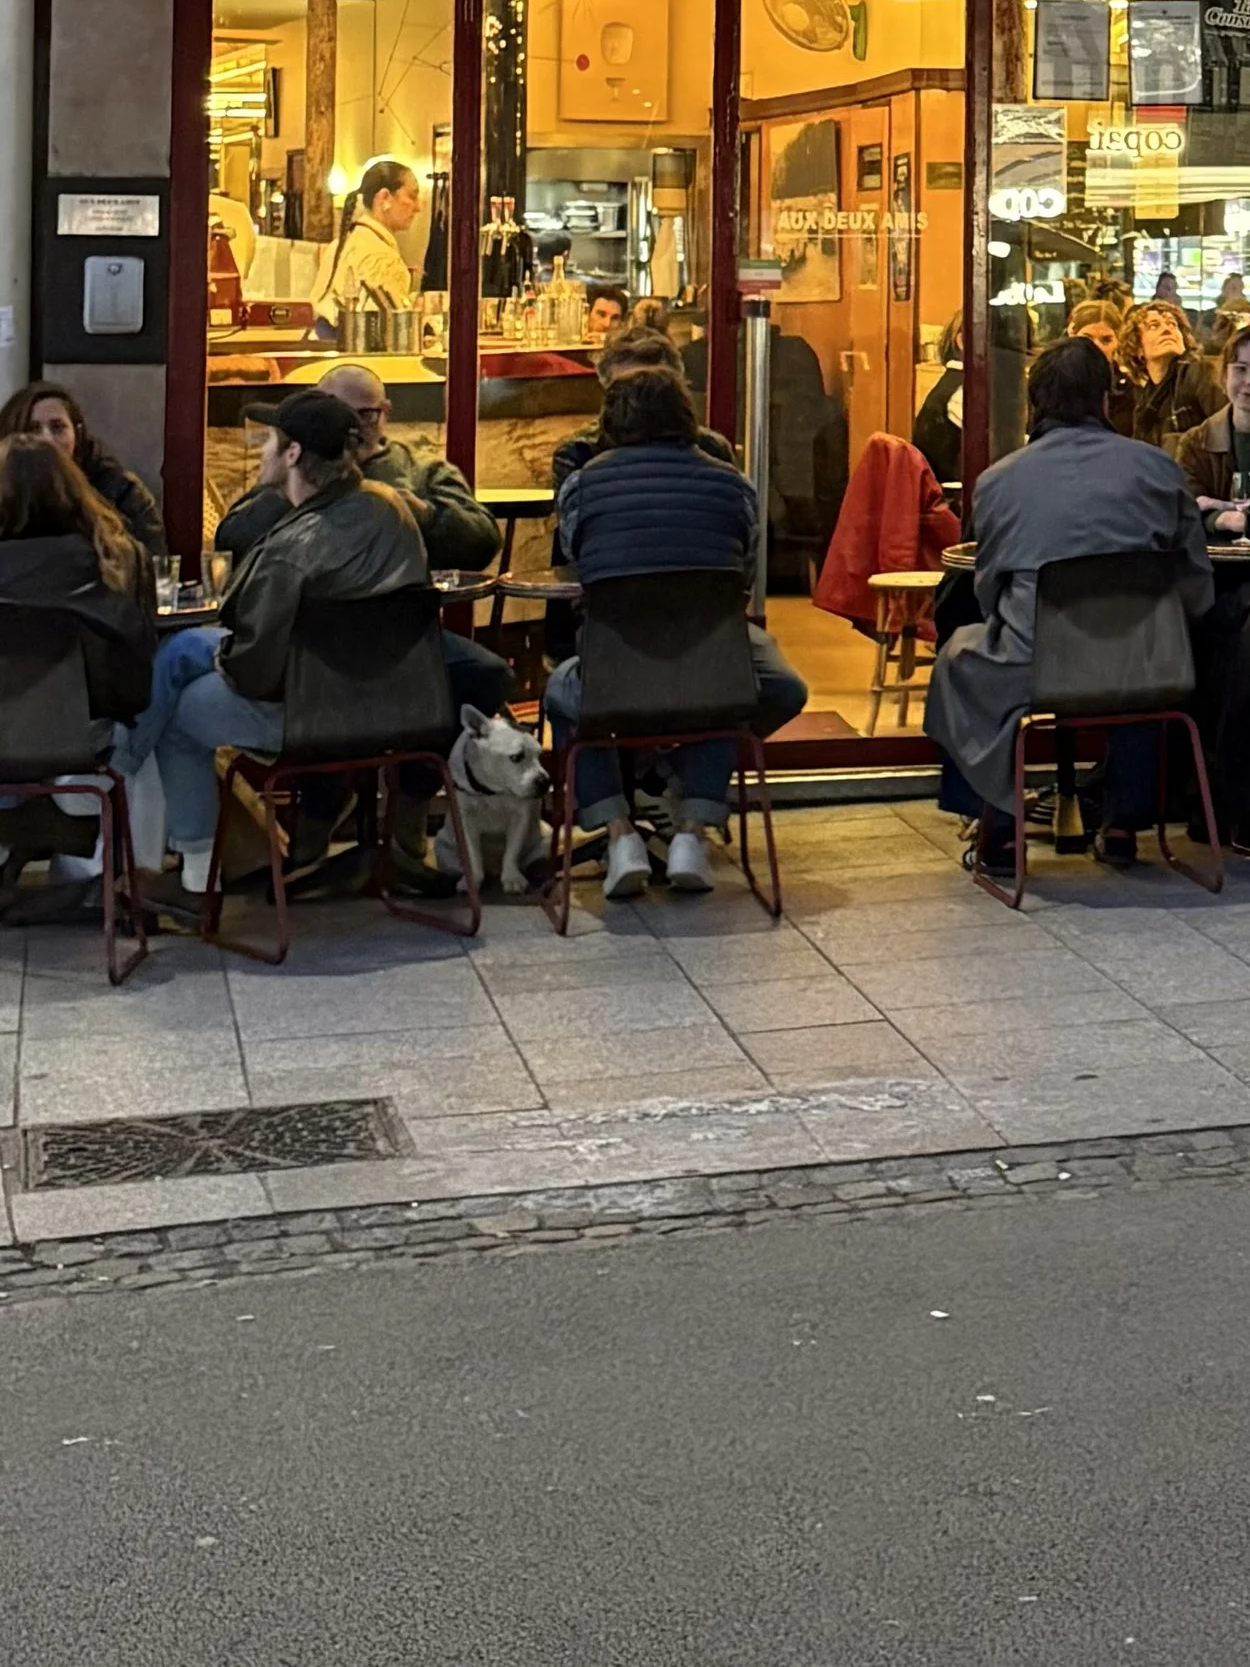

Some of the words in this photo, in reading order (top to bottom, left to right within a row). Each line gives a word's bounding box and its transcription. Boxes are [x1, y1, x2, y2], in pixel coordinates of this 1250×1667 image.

[777, 210, 817, 230] AUX
[823, 211, 875, 231] DEUX
[881, 211, 928, 231] AMIS
